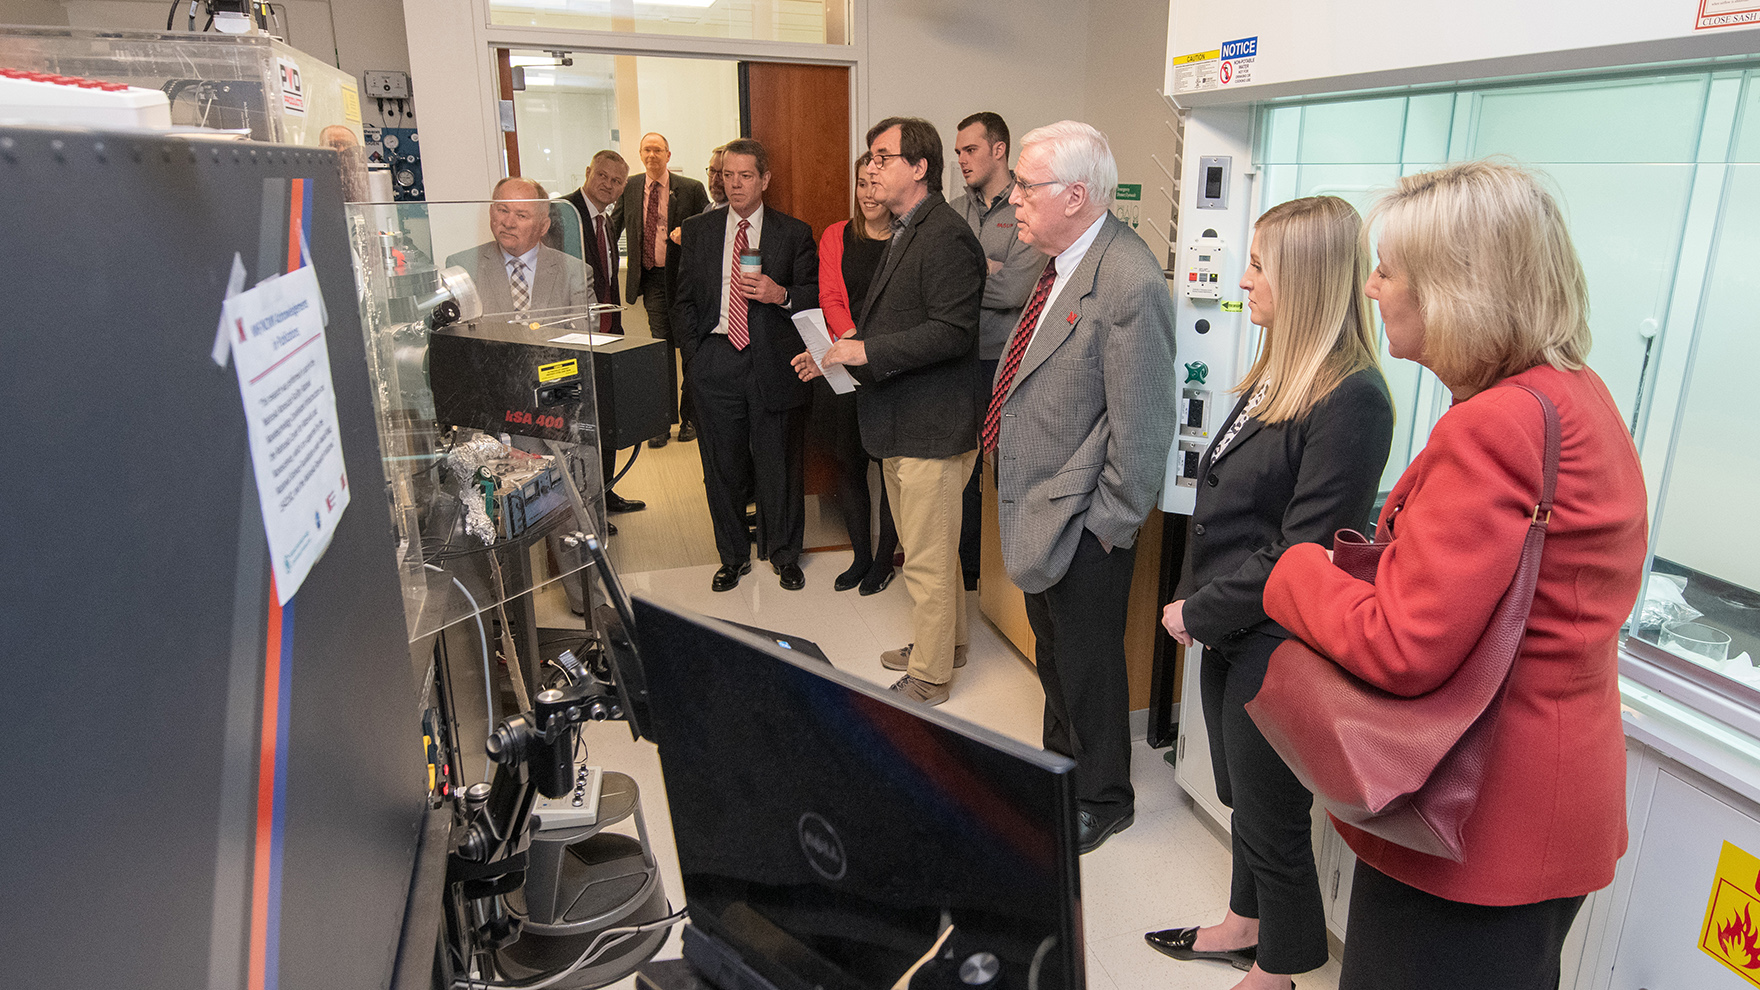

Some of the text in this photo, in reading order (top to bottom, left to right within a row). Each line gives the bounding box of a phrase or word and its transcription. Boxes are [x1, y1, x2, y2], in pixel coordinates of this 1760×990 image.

[1702, 12, 1757, 26] CLOSE SASH
[1222, 40, 1256, 57] NOTICE
[1187, 54, 1205, 62] CAUTION
[280, 64, 301, 91] PVD
[505, 410, 532, 425] kSA
[535, 414, 564, 429] 400
